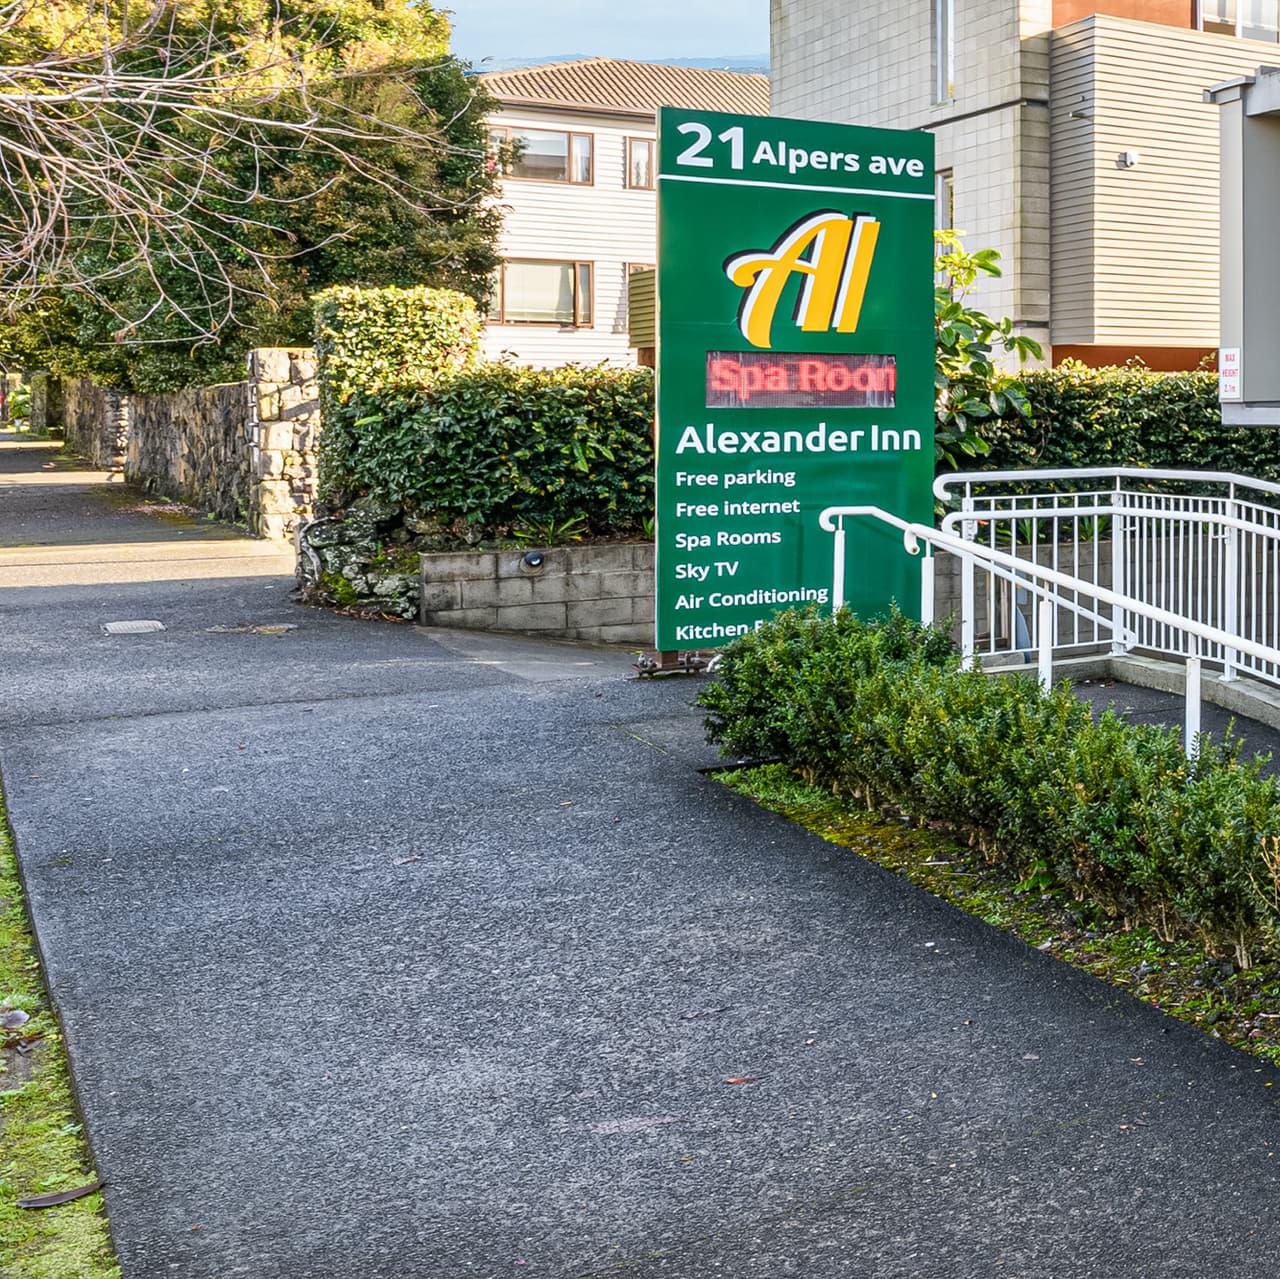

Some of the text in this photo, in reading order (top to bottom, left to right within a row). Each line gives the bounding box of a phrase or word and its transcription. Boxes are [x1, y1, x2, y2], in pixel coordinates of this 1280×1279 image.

[675, 121, 925, 178] 21 Alpers ave
[711, 358, 790, 401] Spa
[675, 422, 922, 455] Alexander Inn
[675, 469, 797, 489] Free parking
[675, 499, 801, 517] Free internet
[675, 530, 782, 552] Spa Rooms
[675, 561, 740, 581] Sky TV
[674, 586, 829, 610] Air Conditioning
[675, 622, 749, 641] Kitchen
